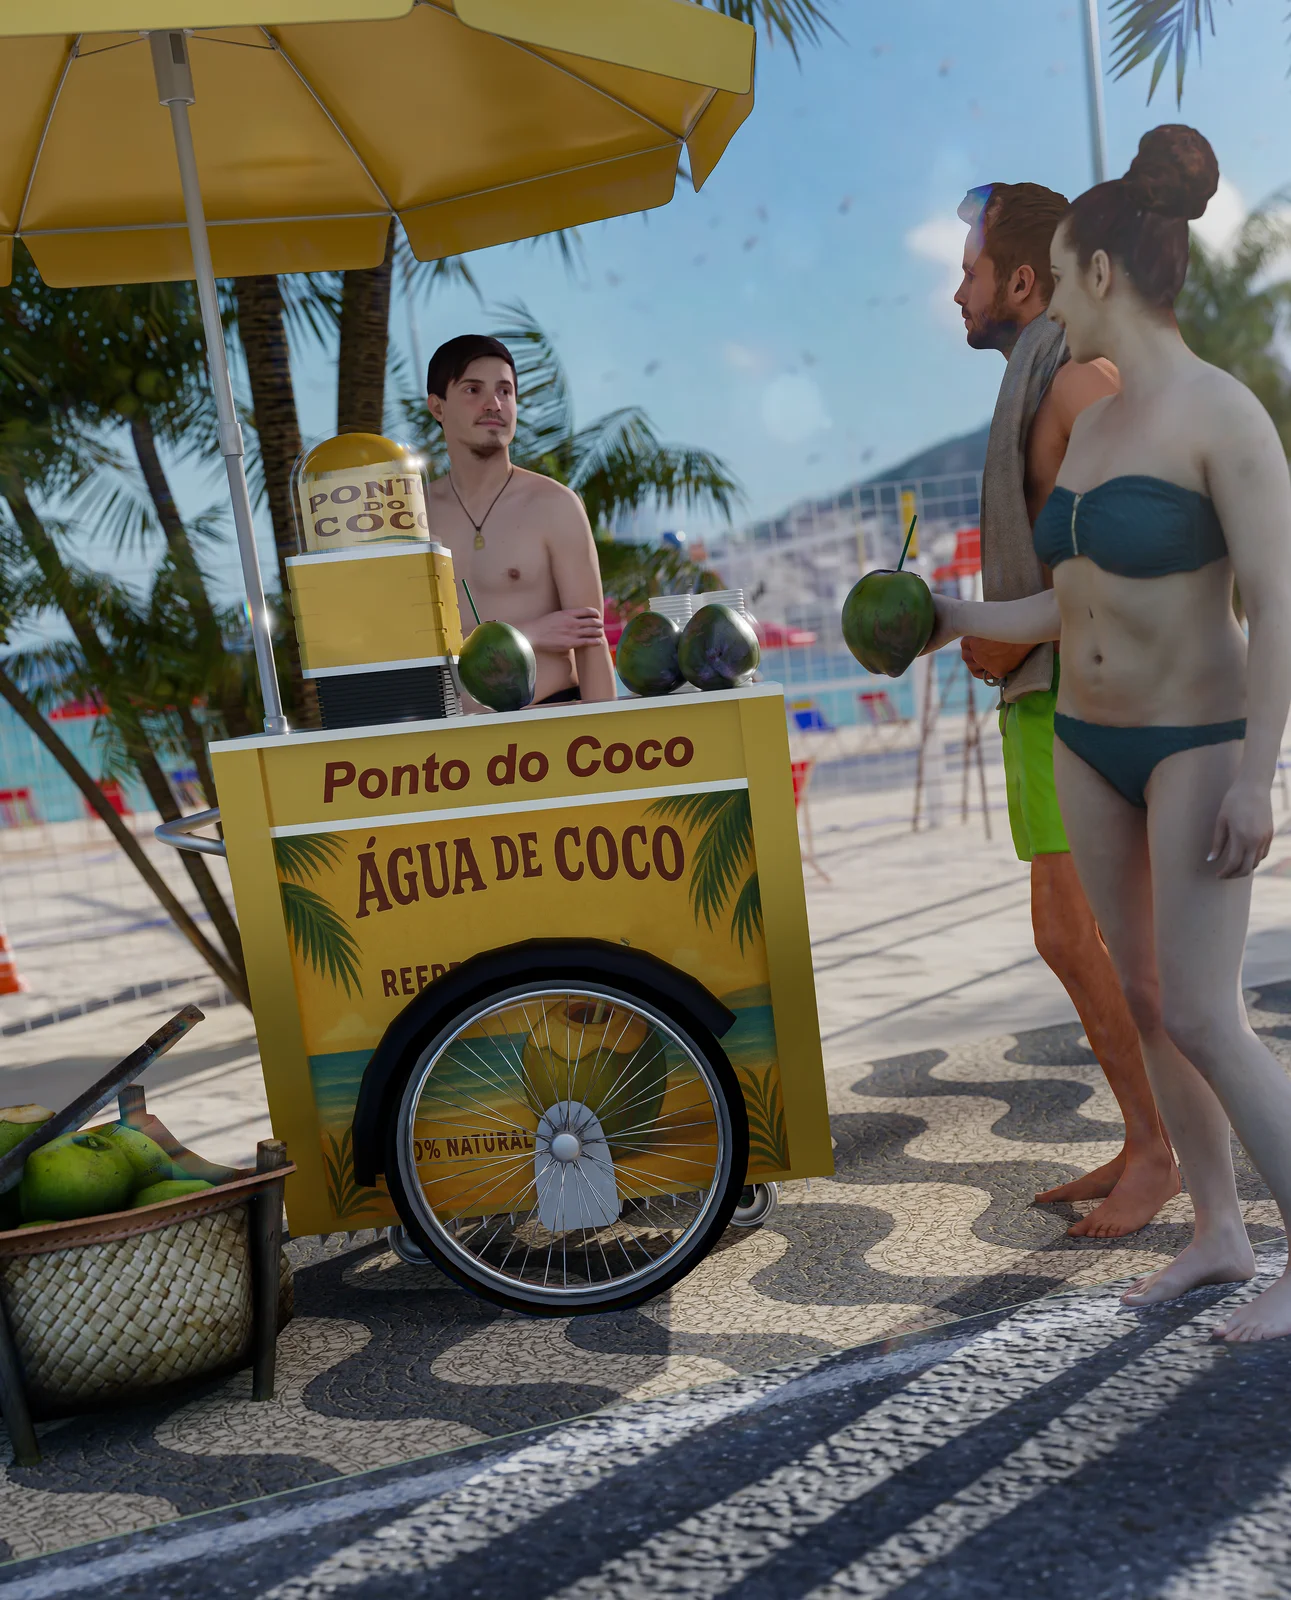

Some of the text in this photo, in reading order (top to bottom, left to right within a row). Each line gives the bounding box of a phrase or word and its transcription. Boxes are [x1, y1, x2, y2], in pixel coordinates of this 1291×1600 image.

[363, 500, 405, 511] DO
[323, 735, 694, 803] Ponto do Coco
[355, 824, 685, 919] ÁGUA DE COCO
[446, 1129, 534, 1157] NATURAL
